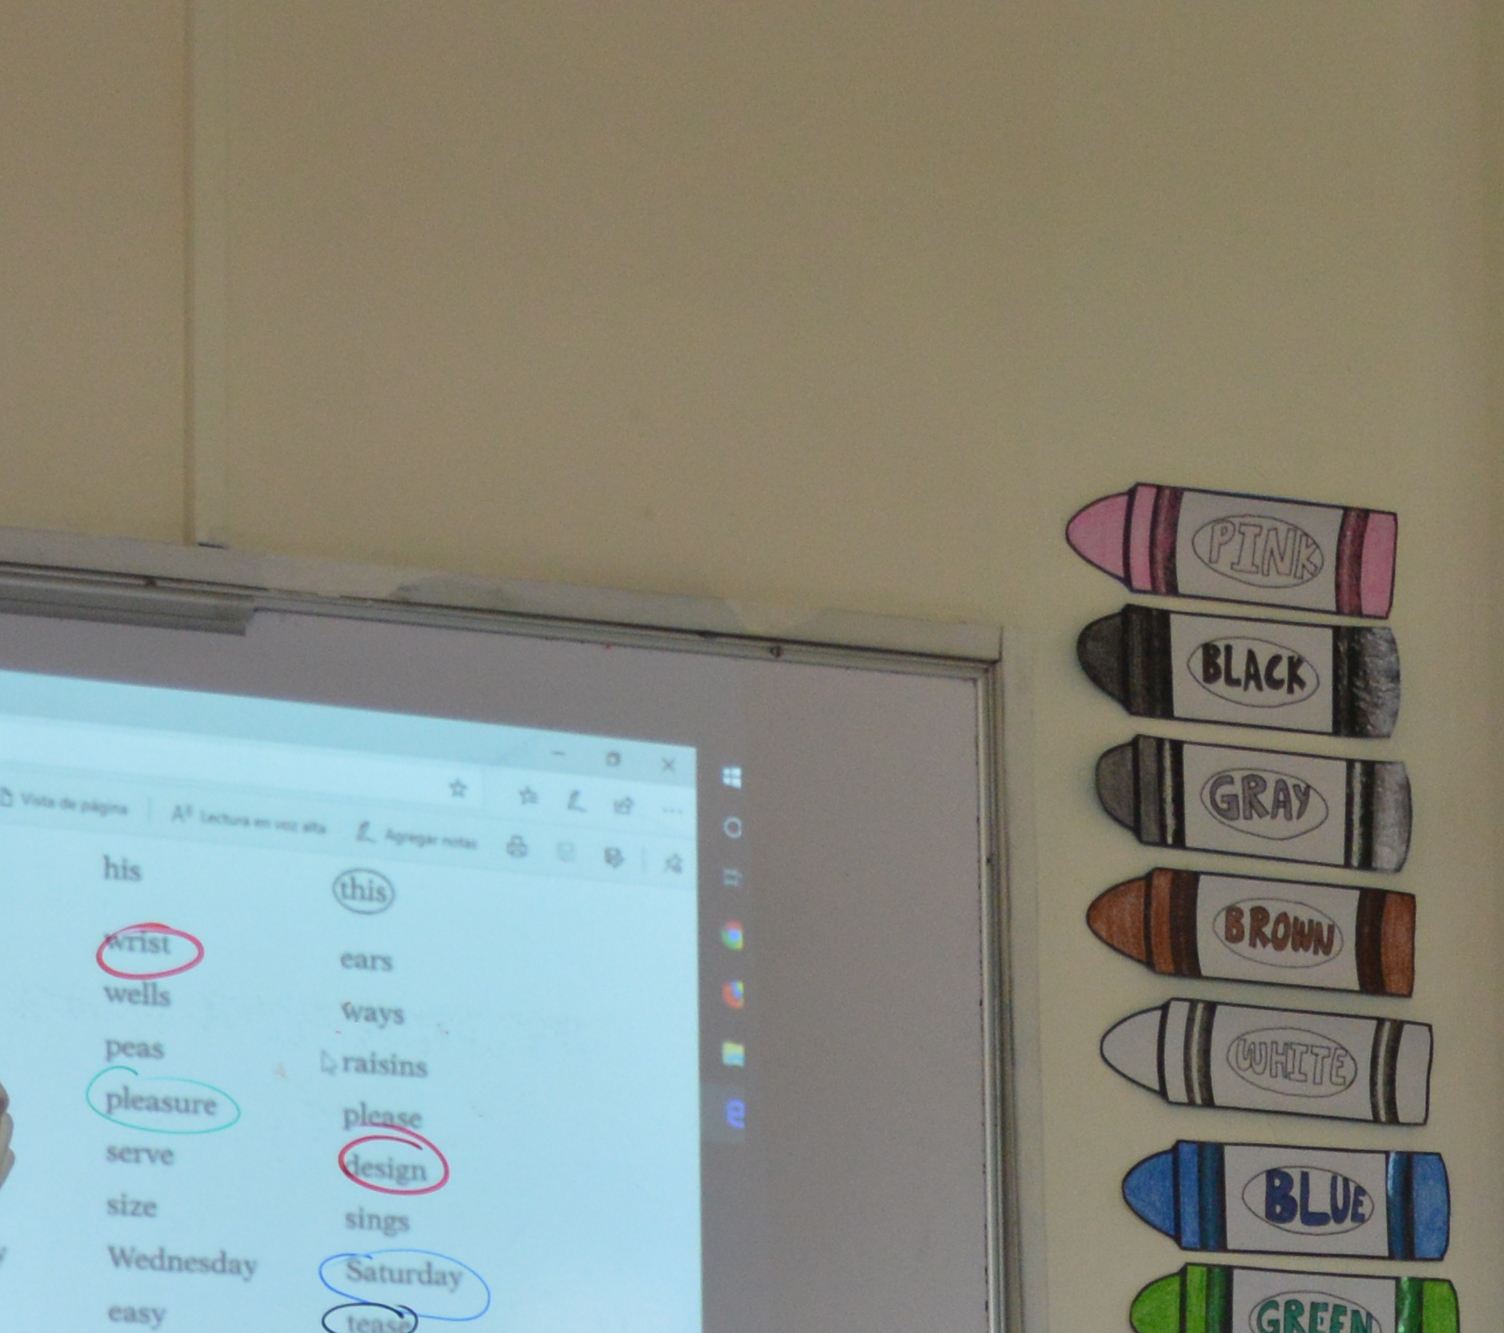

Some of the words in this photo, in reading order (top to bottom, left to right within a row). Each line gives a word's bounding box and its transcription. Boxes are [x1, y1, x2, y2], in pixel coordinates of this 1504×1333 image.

[1208, 517, 1320, 579] PINK
[1201, 641, 1306, 695] BLACK
[21, 792, 55, 808] Vista
[59, 796, 77, 811] de
[81, 800, 129, 818] página
[1208, 773, 1312, 821] GRAY
[200, 809, 250, 828] Lectura
[254, 816, 271, 829] en
[302, 820, 327, 835] alta
[385, 829, 439, 849] Agregar
[442, 834, 479, 850] notas
[103, 854, 142, 882] his
[339, 874, 388, 903] this
[104, 931, 172, 956] wrist
[340, 949, 394, 972] ears
[1224, 905, 1336, 957] BROWN
[104, 982, 172, 1008] wells
[341, 1003, 406, 1030] ways
[105, 1037, 166, 1063] peas
[342, 1051, 429, 1079] raisins
[1235, 1037, 1348, 1087] WHITE
[105, 1085, 218, 1117] pleasure
[343, 1101, 424, 1131] please
[105, 1143, 176, 1169] serve
[345, 1154, 428, 1185] design
[106, 1194, 159, 1220] size
[344, 1207, 411, 1238] sings
[1264, 1167, 1368, 1226] BLUE
[107, 1245, 259, 1284] Wednesday
[346, 1259, 464, 1293] Saturday
[108, 1304, 166, 1331] easy
